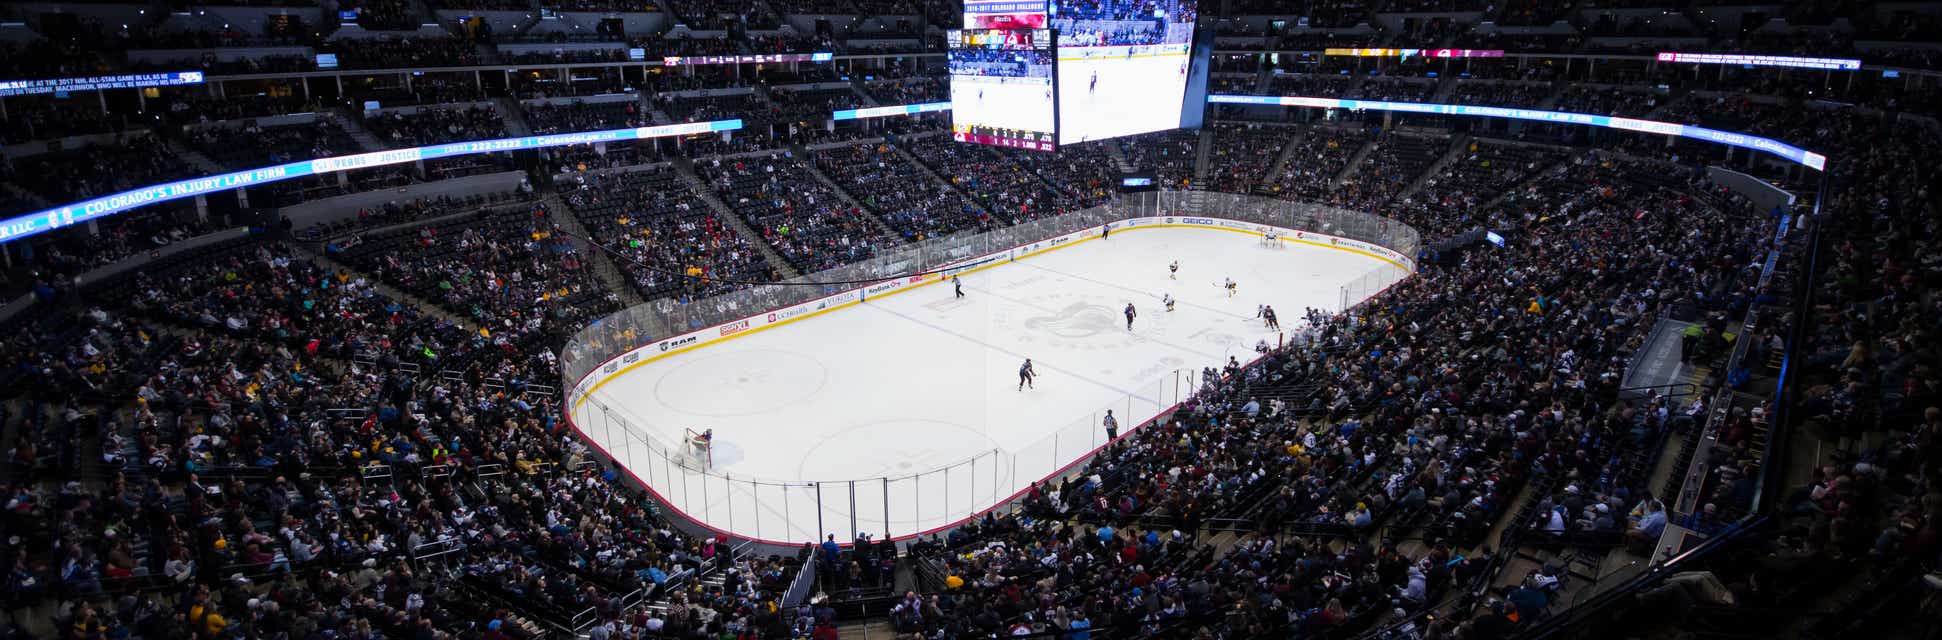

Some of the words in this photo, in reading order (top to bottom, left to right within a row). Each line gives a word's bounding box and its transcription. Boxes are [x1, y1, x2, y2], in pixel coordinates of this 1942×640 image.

[470, 139, 521, 152] 222-2222
[380, 149, 418, 163] JUSTICE
[85, 187, 168, 215] COLORADO'S
[171, 178, 220, 197] INJURY
[225, 173, 254, 187] LAW
[256, 167, 286, 181] FIRM
[1182, 217, 1213, 225] GEICO
[12, 220, 35, 236] LLC
[868, 283, 890, 294] KeyBank
[671, 335, 697, 347] RAM
